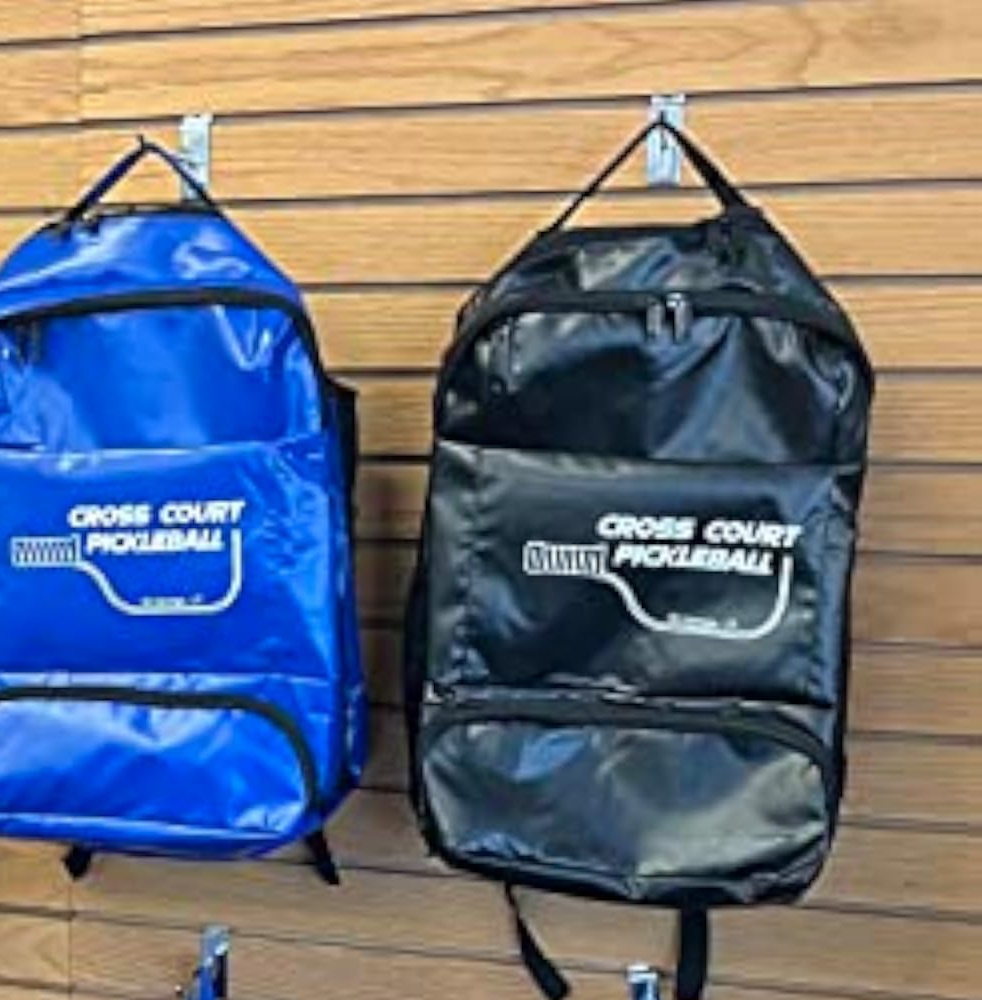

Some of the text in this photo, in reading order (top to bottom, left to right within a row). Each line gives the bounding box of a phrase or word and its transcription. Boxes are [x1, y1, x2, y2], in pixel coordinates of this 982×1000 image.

[69, 500, 246, 528] CROSS COURT
[85, 528, 224, 555] PICKLEBALL
[595, 513, 803, 547] CROSS COURT
[612, 543, 774, 575] PICKLEBALL
